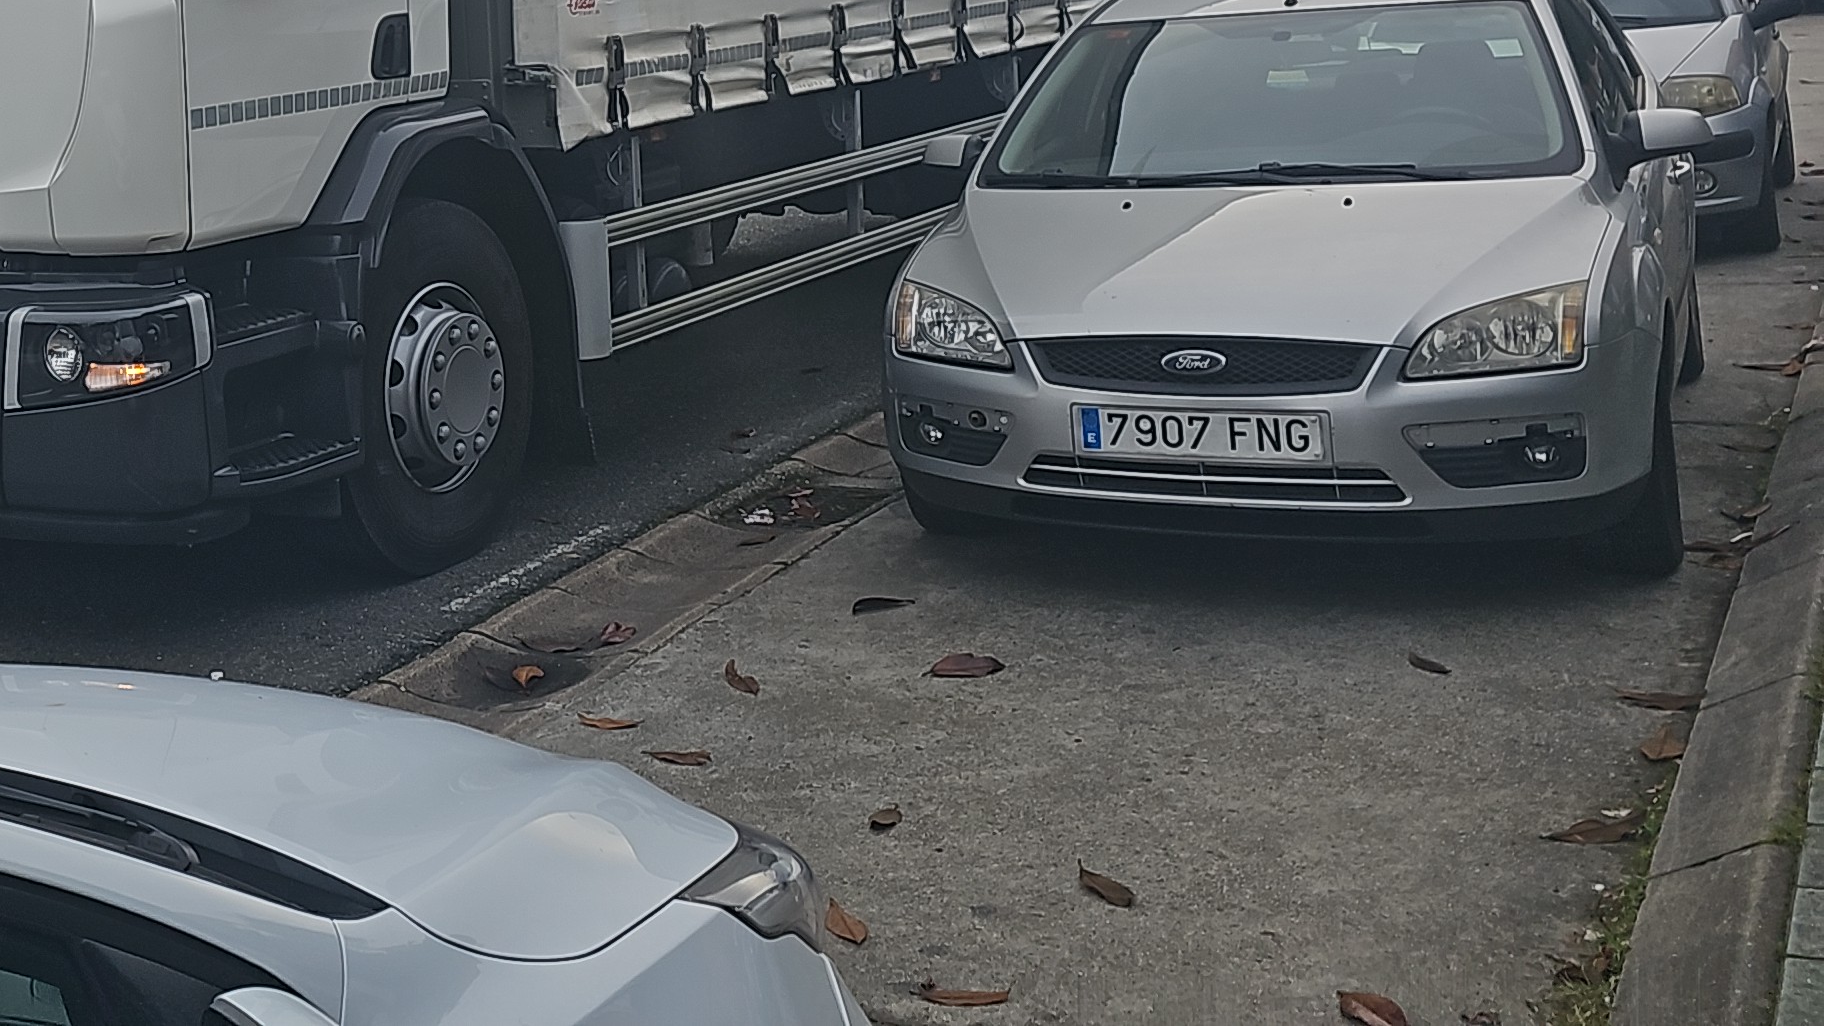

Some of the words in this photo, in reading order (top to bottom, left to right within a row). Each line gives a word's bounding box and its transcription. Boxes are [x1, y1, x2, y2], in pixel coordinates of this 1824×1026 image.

[1176, 355, 1210, 369] Ford
[1087, 433, 1097, 443] E
[1107, 413, 1211, 450] 7907
[1228, 416, 1310, 453] FNG
